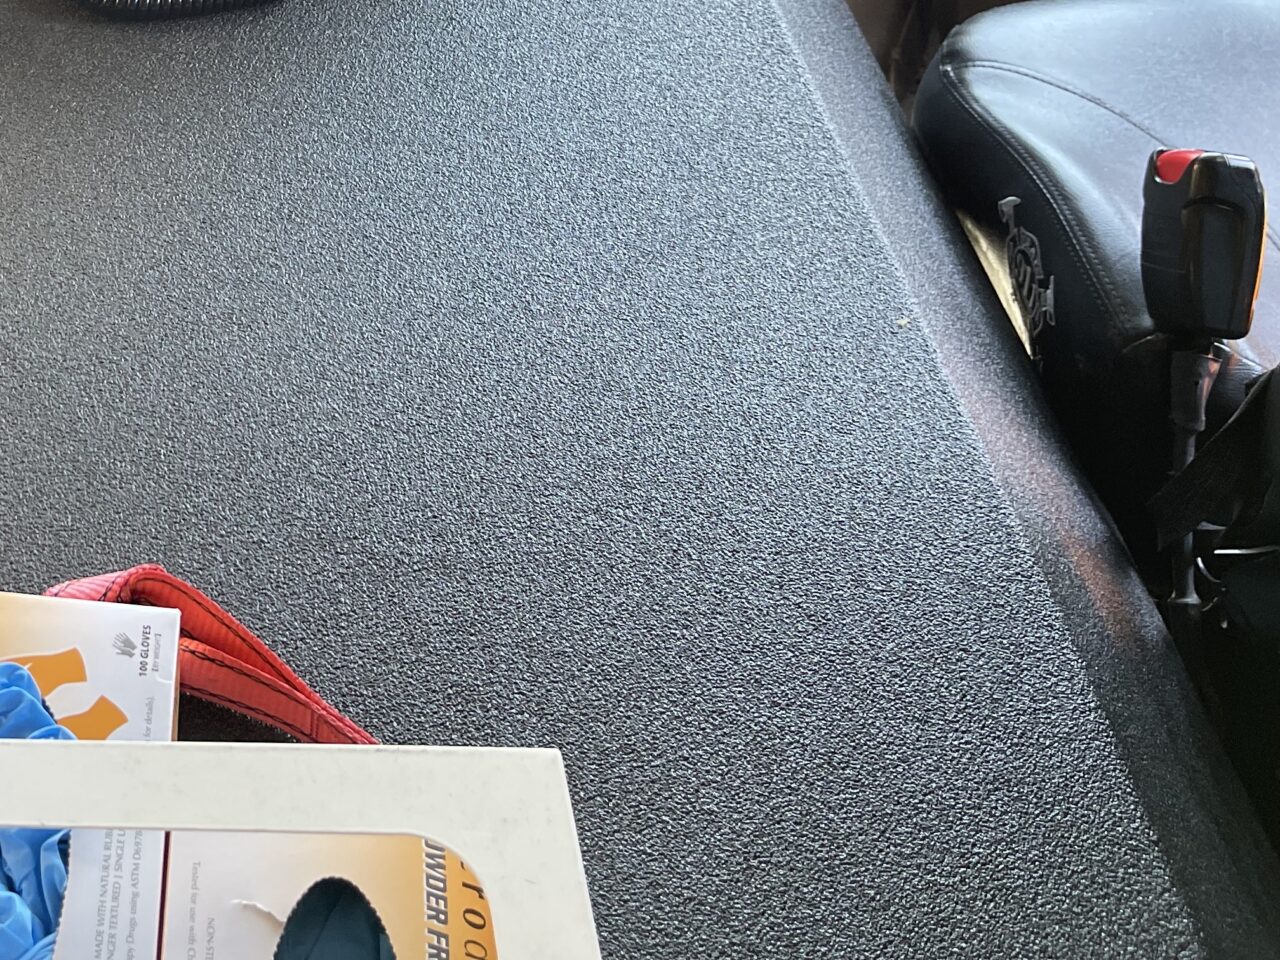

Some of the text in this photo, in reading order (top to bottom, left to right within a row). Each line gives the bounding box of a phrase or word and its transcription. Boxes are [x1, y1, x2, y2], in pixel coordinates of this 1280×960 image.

[138, 624, 152, 677] 100 GLOVES
[114, 839, 125, 872] SINGLE
[99, 853, 111, 898] NATURAL
[132, 862, 141, 889] ASTM
[190, 861, 201, 890] Tested
[109, 881, 121, 930] TEXTURED
[129, 890, 140, 914] using
[190, 892, 199, 905] for
[96, 900, 107, 927] WITH
[126, 917, 137, 944] Drugs
[188, 925, 196, 946] with
[94, 930, 105, 960] MADE
